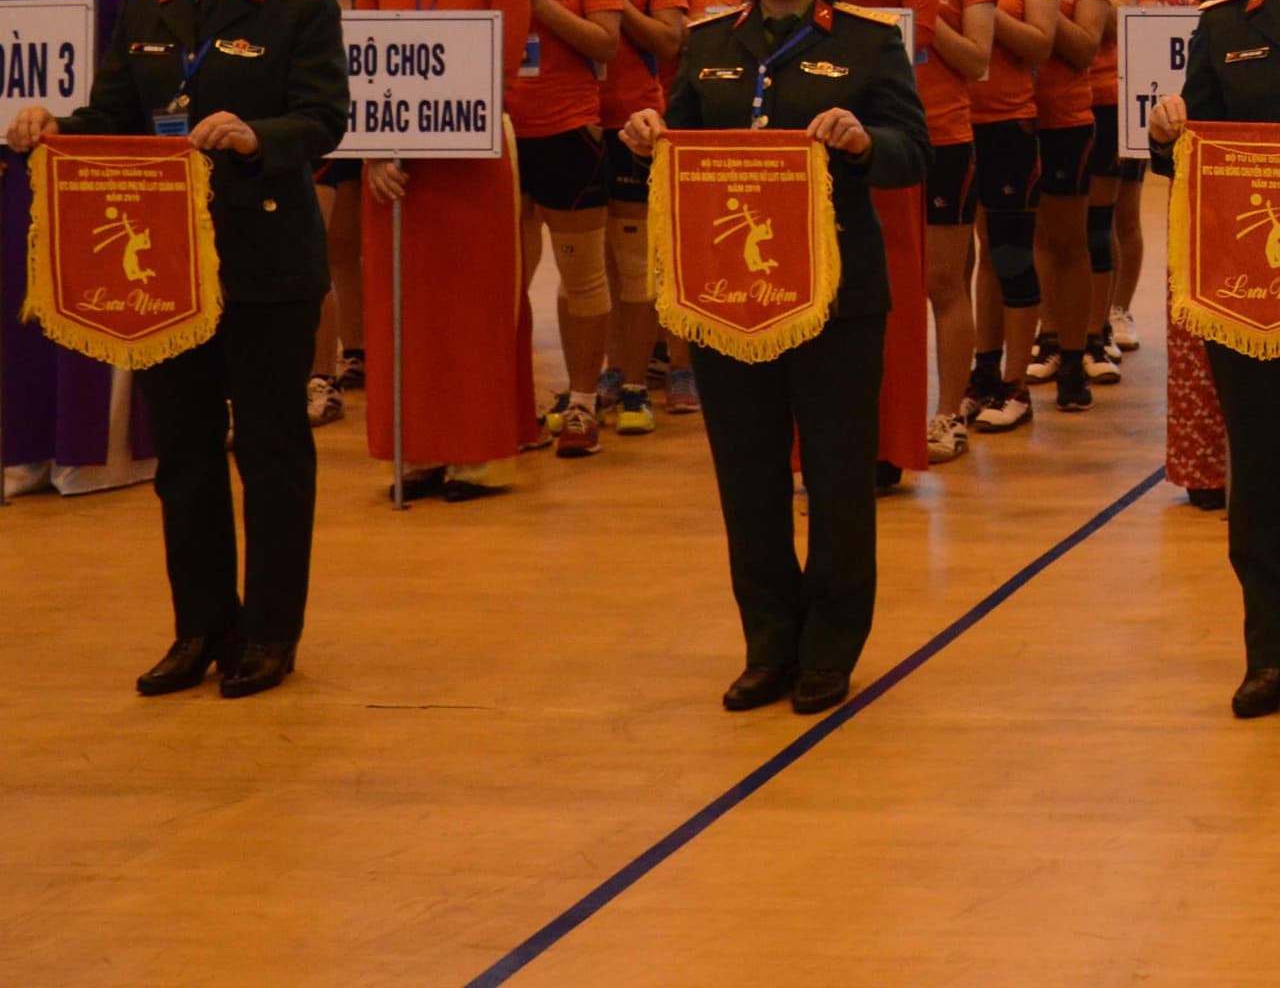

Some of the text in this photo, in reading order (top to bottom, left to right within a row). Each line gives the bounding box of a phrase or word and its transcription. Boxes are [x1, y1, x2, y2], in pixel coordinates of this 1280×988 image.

[59, 42, 75, 98] 3
[349, 36, 445, 84] BỘ CHQS
[365, 88, 409, 132] BẮC
[418, 100, 486, 132] GIANG
[698, 279, 798, 307] Lưu Niệm
[1216, 274, 1267, 299] Lưu
